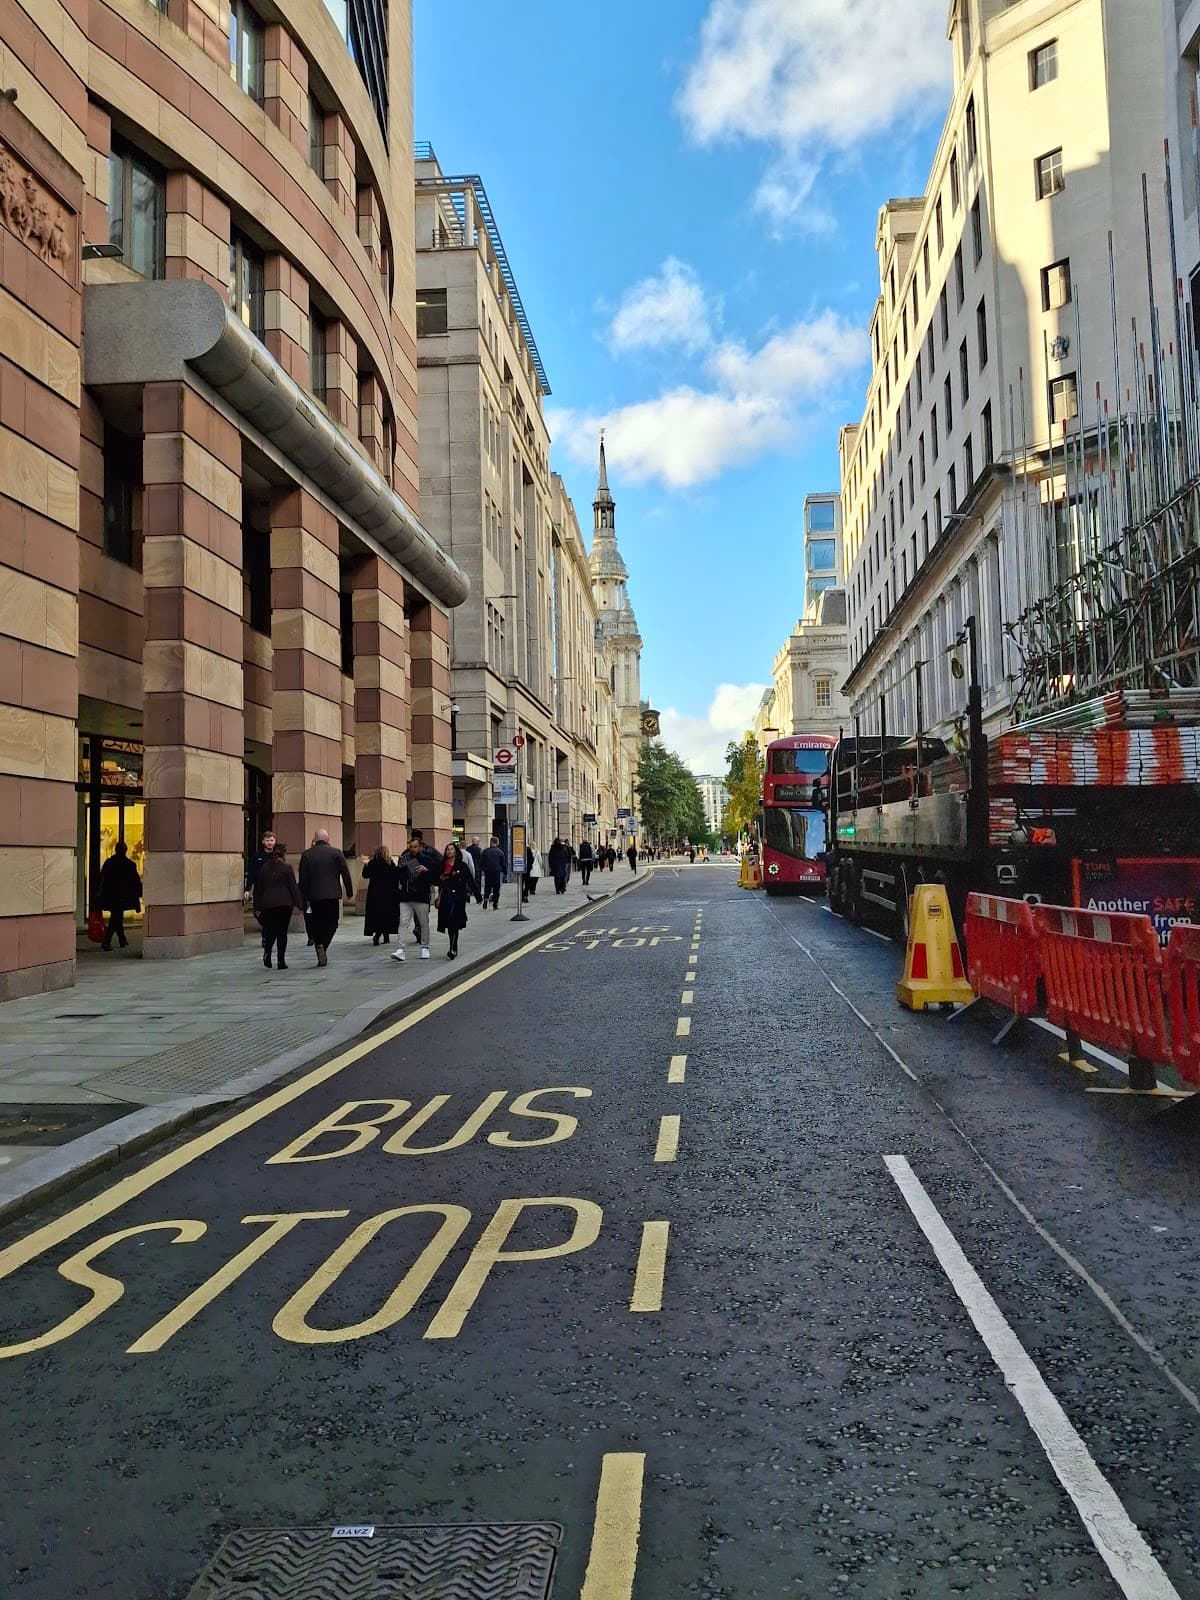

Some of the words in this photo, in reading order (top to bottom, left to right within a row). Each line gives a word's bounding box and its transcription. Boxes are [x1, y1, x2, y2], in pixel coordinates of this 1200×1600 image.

[794, 741, 832, 749] Emirates
[1087, 897, 1150, 912] Another
[1153, 897, 1194, 912] SAFE
[1153, 914, 1192, 927] from
[574, 925, 671, 937] BUS
[538, 935, 683, 953] STOP
[265, 1086, 593, 1164] BUS
[0, 1196, 603, 1358] STOP
[336, 1528, 369, 1536] ZAYO
